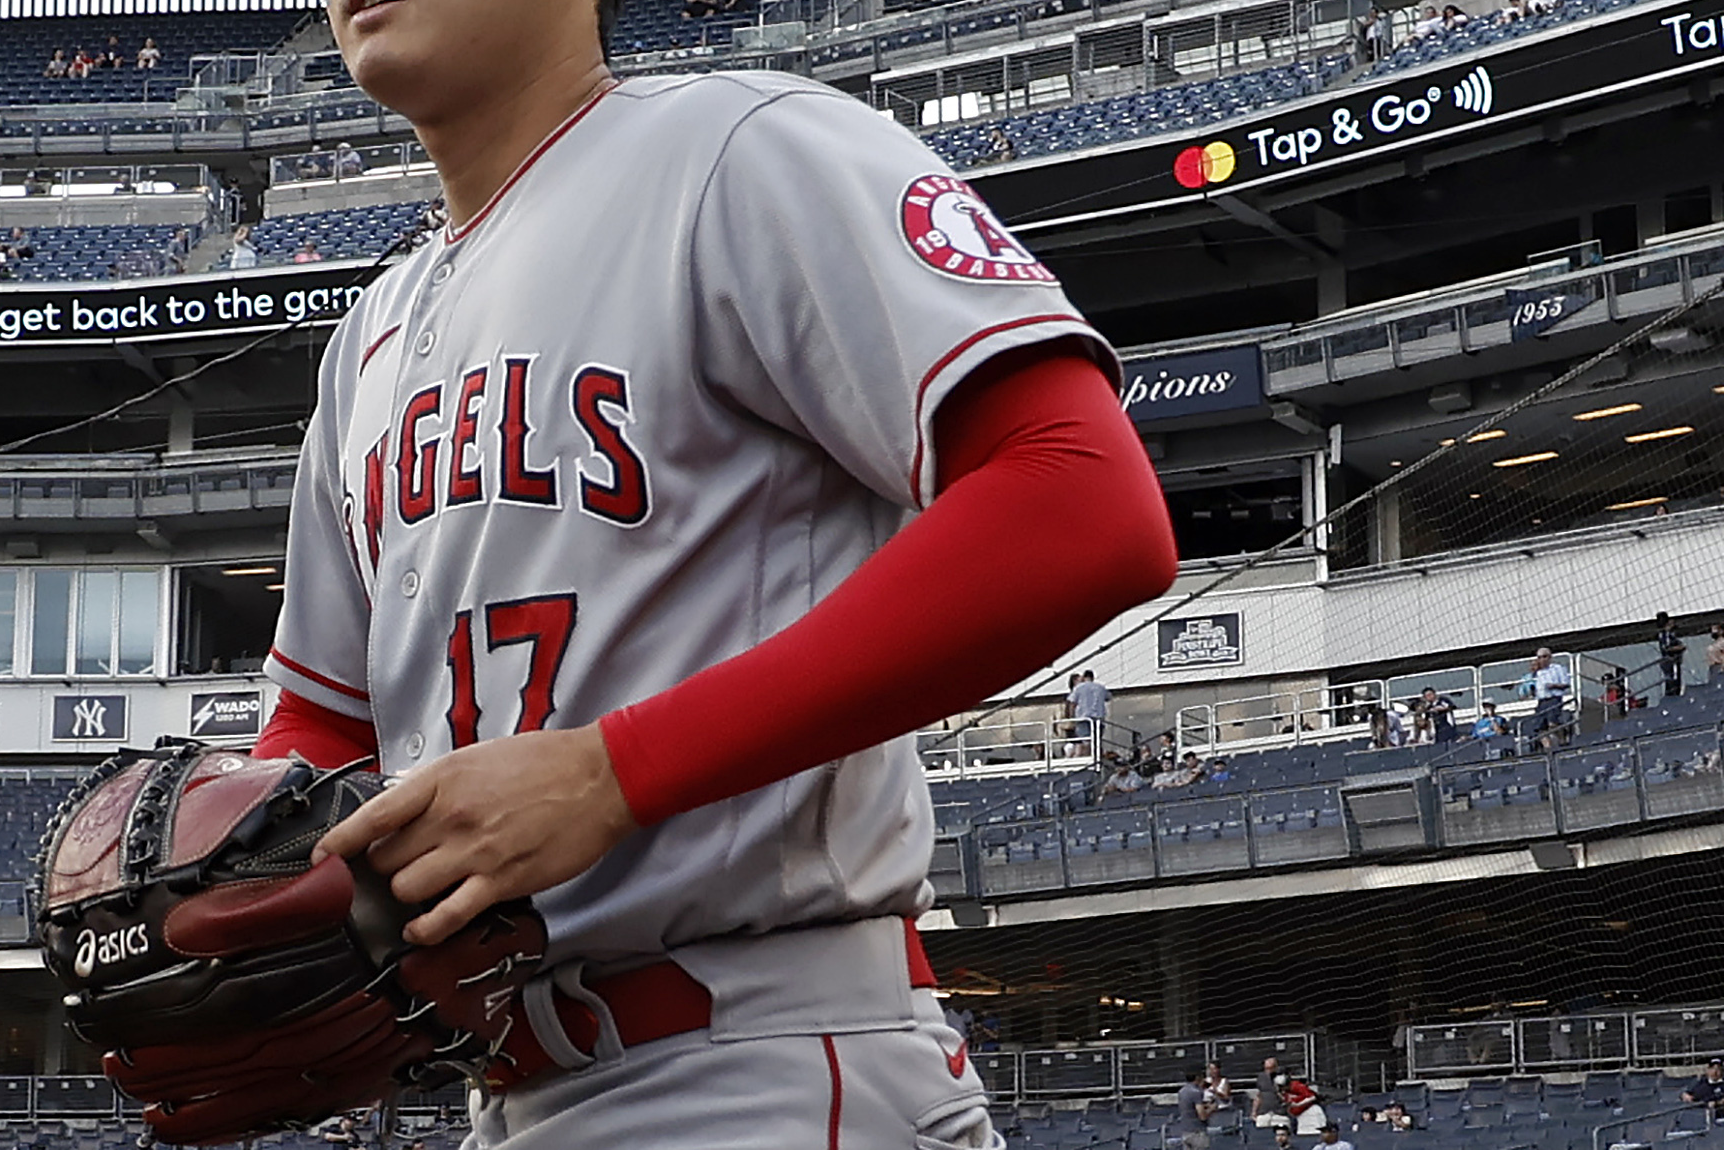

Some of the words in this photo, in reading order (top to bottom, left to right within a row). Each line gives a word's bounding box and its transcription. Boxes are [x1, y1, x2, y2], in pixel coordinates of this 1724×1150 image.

[1660, 12, 1724, 55] Ta
[1247, 127, 1323, 166] Tap
[1332, 108, 1364, 145] &
[72, 296, 158, 331] back
[165, 296, 207, 325] to
[214, 287, 275, 319] the
[1120, 371, 1236, 412] pions
[446, 592, 578, 750] 17
[213, 699, 260, 715] WADO
[97, 922, 150, 966] asics
